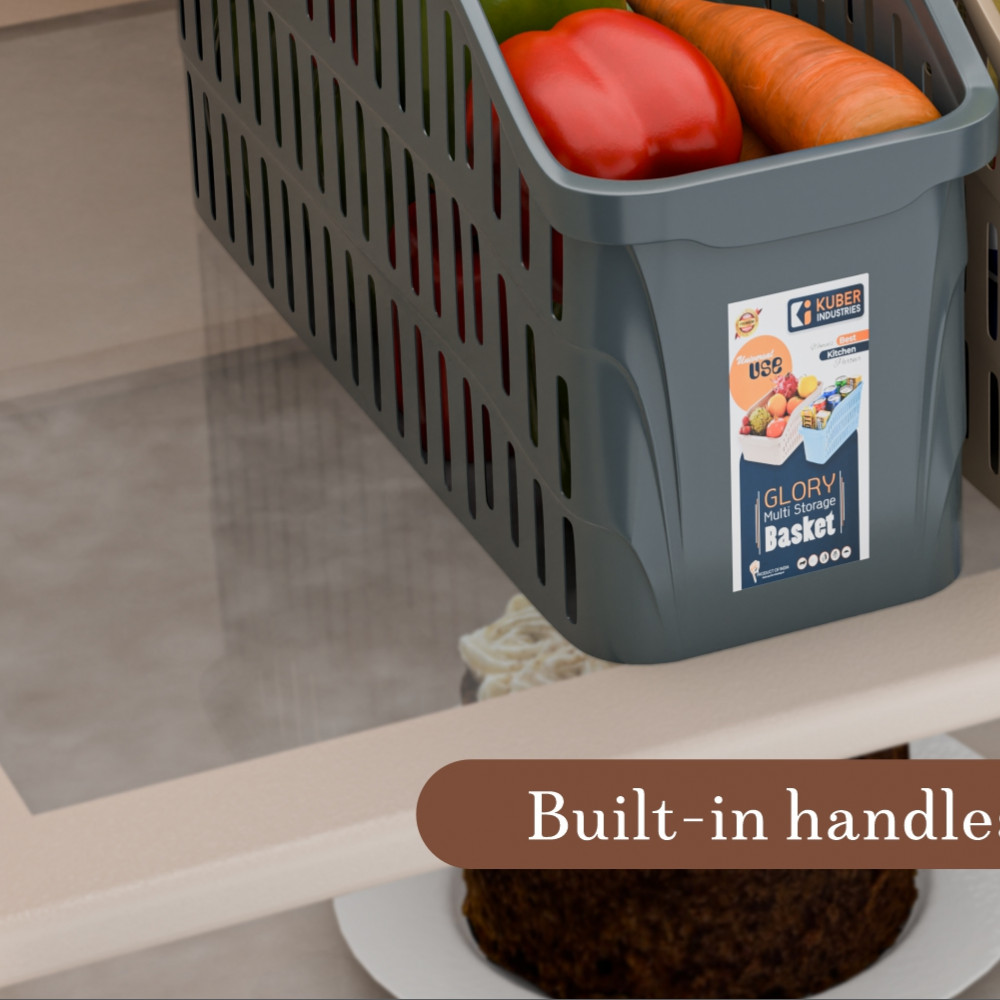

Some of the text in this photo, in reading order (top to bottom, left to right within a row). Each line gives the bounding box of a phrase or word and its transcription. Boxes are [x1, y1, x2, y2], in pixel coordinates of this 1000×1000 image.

[816, 288, 862, 312] KUBER
[816, 304, 861, 322] INDUSTRIES
[827, 346, 857, 359] Kitchen
[764, 472, 836, 508] GLORY
[764, 497, 836, 523] Multi Storage
[764, 511, 836, 553] Basket
